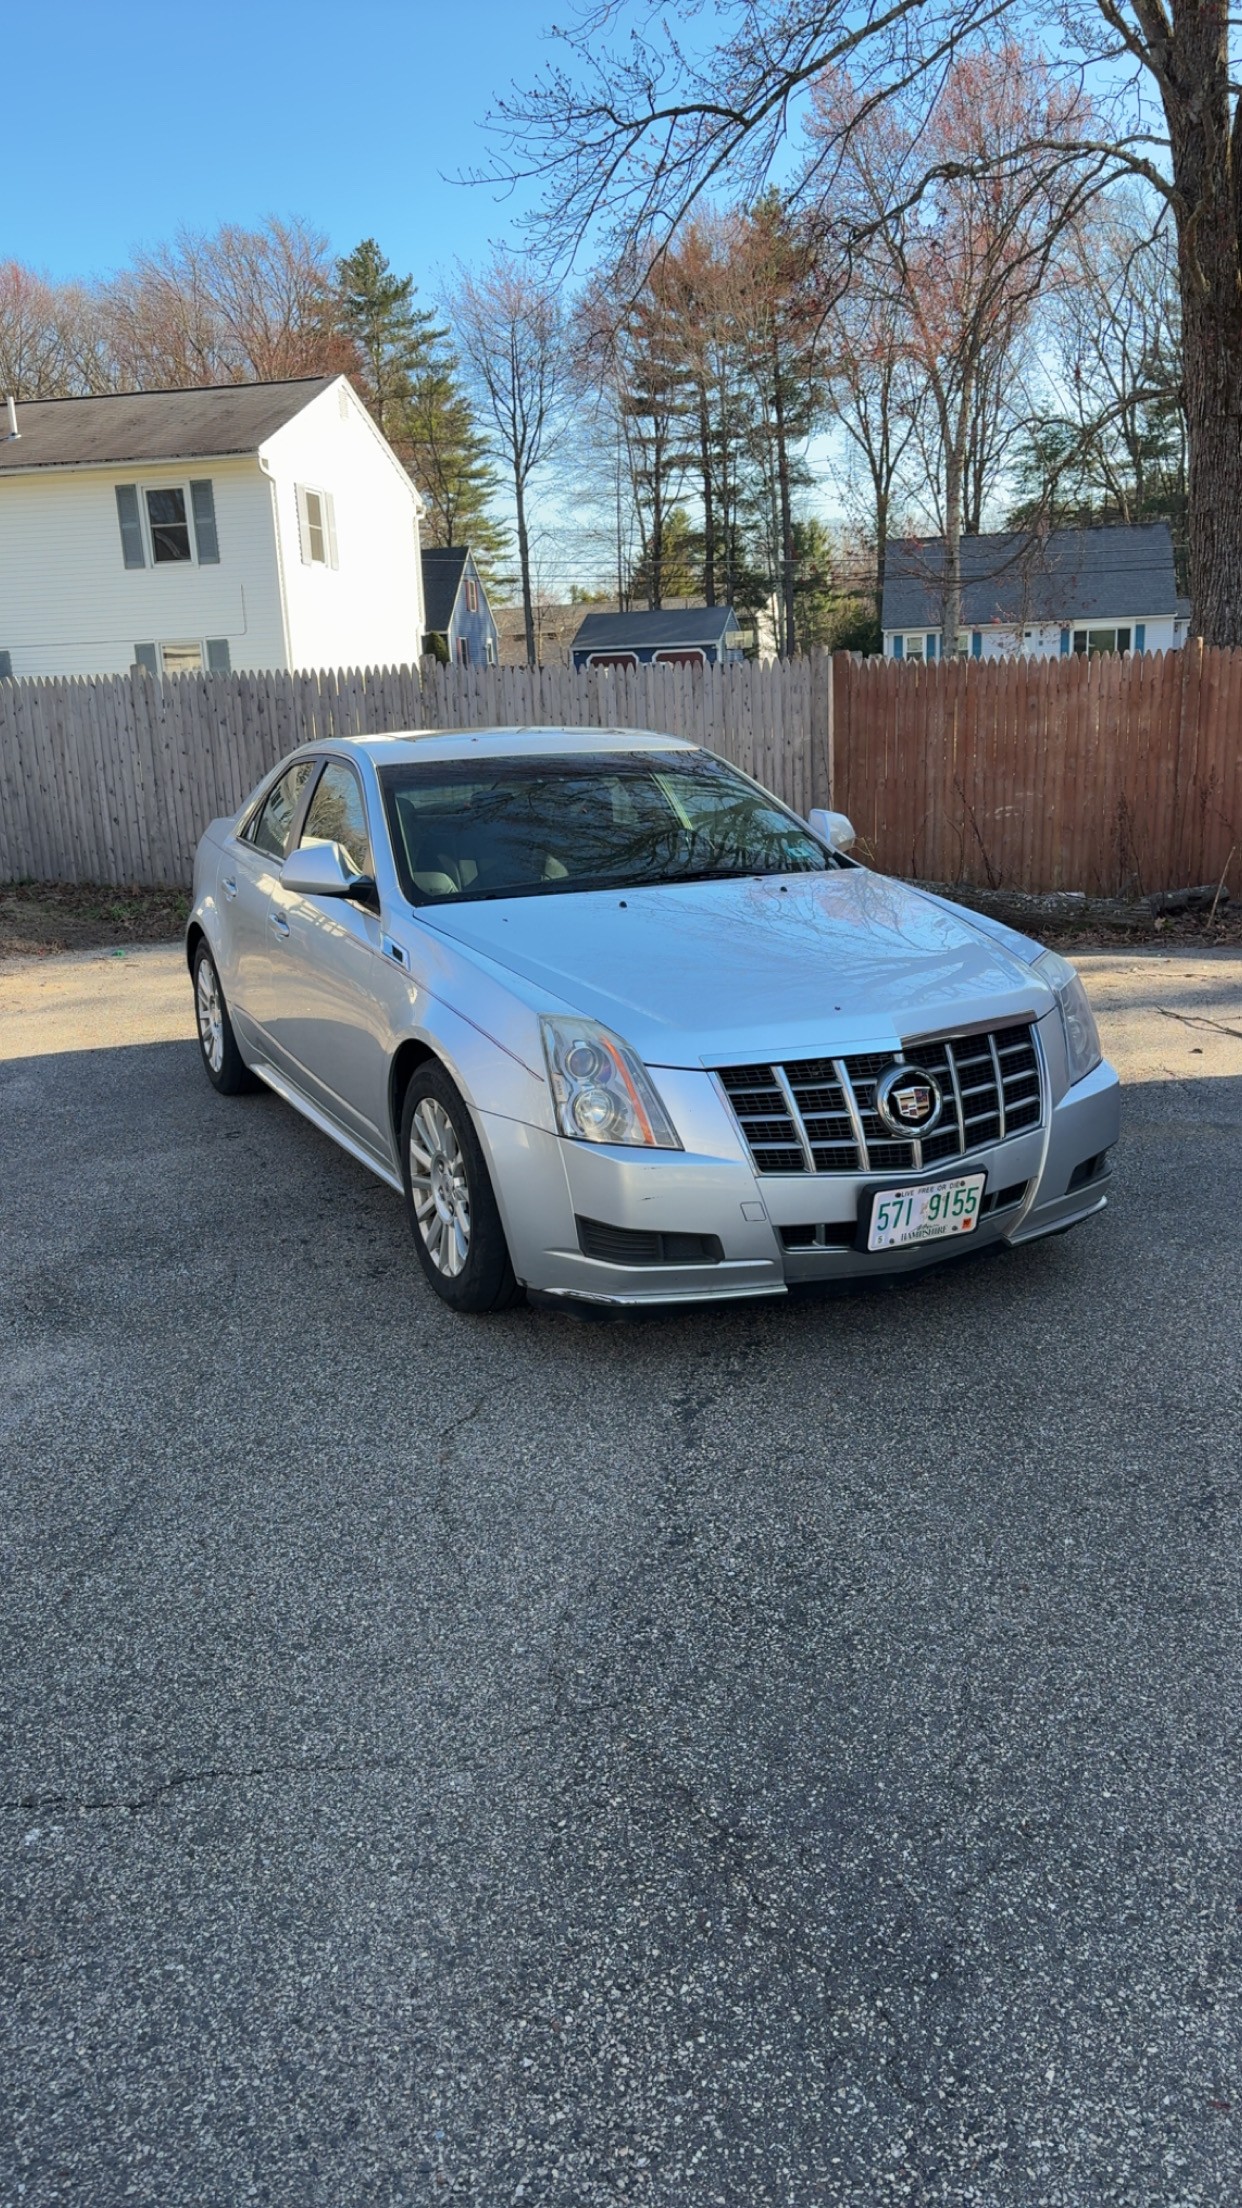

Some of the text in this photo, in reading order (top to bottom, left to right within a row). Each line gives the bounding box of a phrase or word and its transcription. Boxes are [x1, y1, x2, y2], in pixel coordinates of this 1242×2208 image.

[918, 1186, 934, 1194] FREE
[877, 1187, 979, 1231] 571 9155
[901, 1226, 947, 1241] HAMPSHIRE
